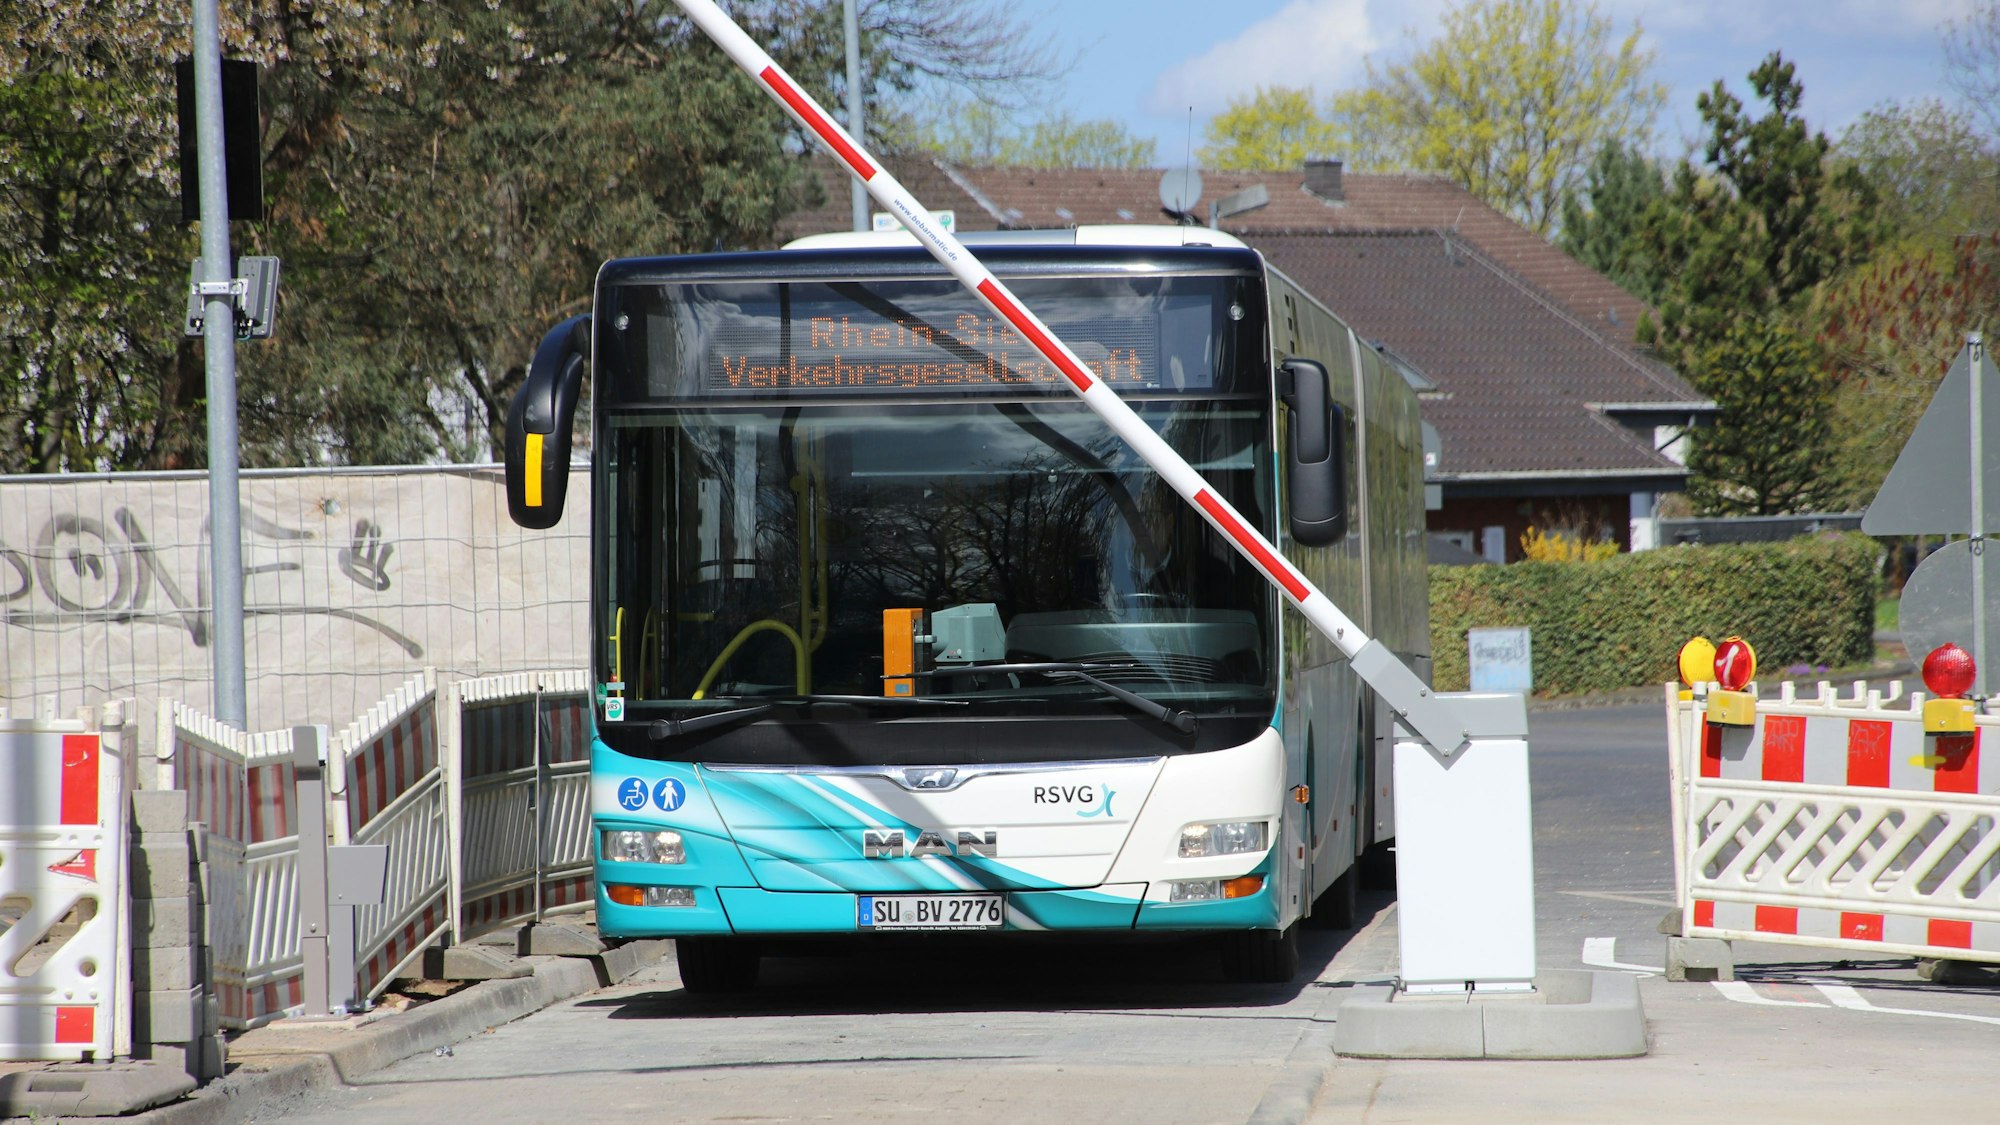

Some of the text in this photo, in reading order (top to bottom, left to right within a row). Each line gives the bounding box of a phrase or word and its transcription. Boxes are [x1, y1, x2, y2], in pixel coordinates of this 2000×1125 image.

[893, 198, 958, 262] www.bebarmatic.de
[810, 314, 1022, 348] Rhein-Sie
[722, 347, 1142, 387] Verkehrsgesellscaft
[1034, 785, 1094, 804] RSVG
[863, 830, 998, 859] MAN
[874, 900, 900, 922] SU
[917, 900, 942, 922] BV
[948, 899, 1000, 922] 2776
